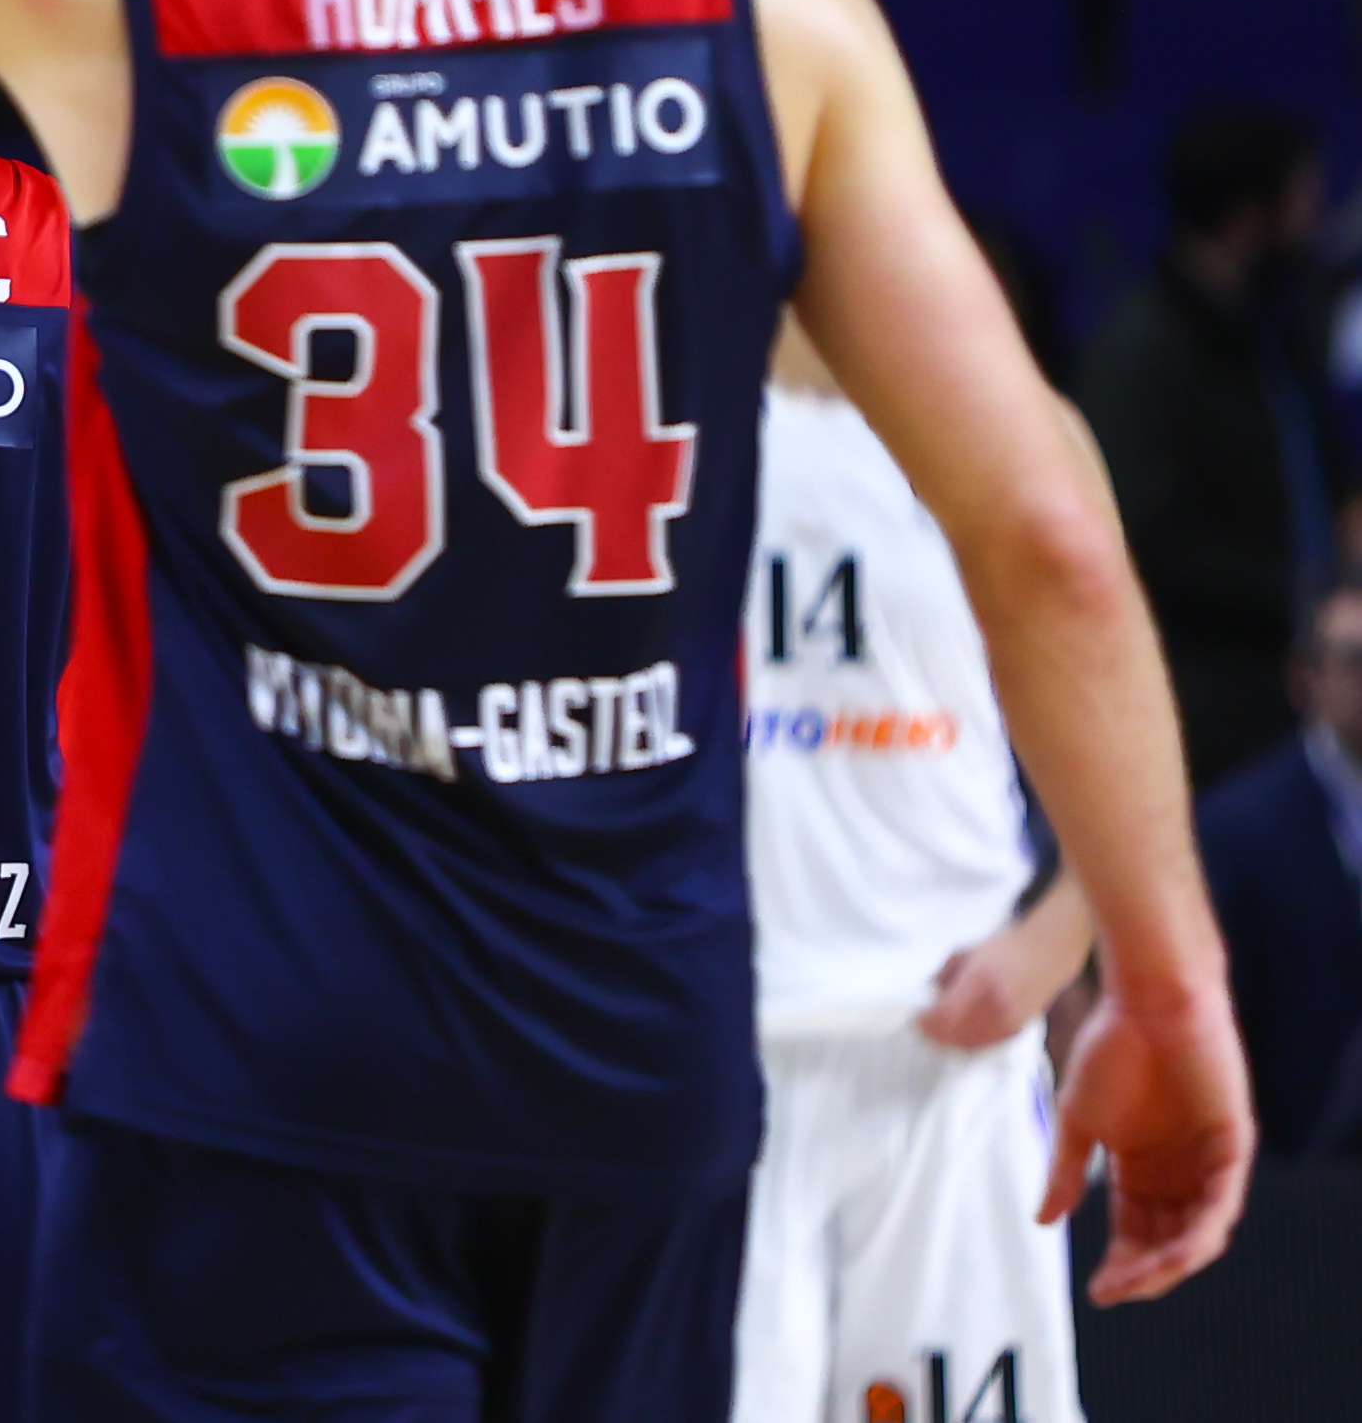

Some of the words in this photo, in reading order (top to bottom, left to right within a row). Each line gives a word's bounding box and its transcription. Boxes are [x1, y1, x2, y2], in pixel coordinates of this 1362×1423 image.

[358, 76, 707, 176] AMUTIO
[217, 236, 700, 601] 34
[764, 546, 868, 664] 14
